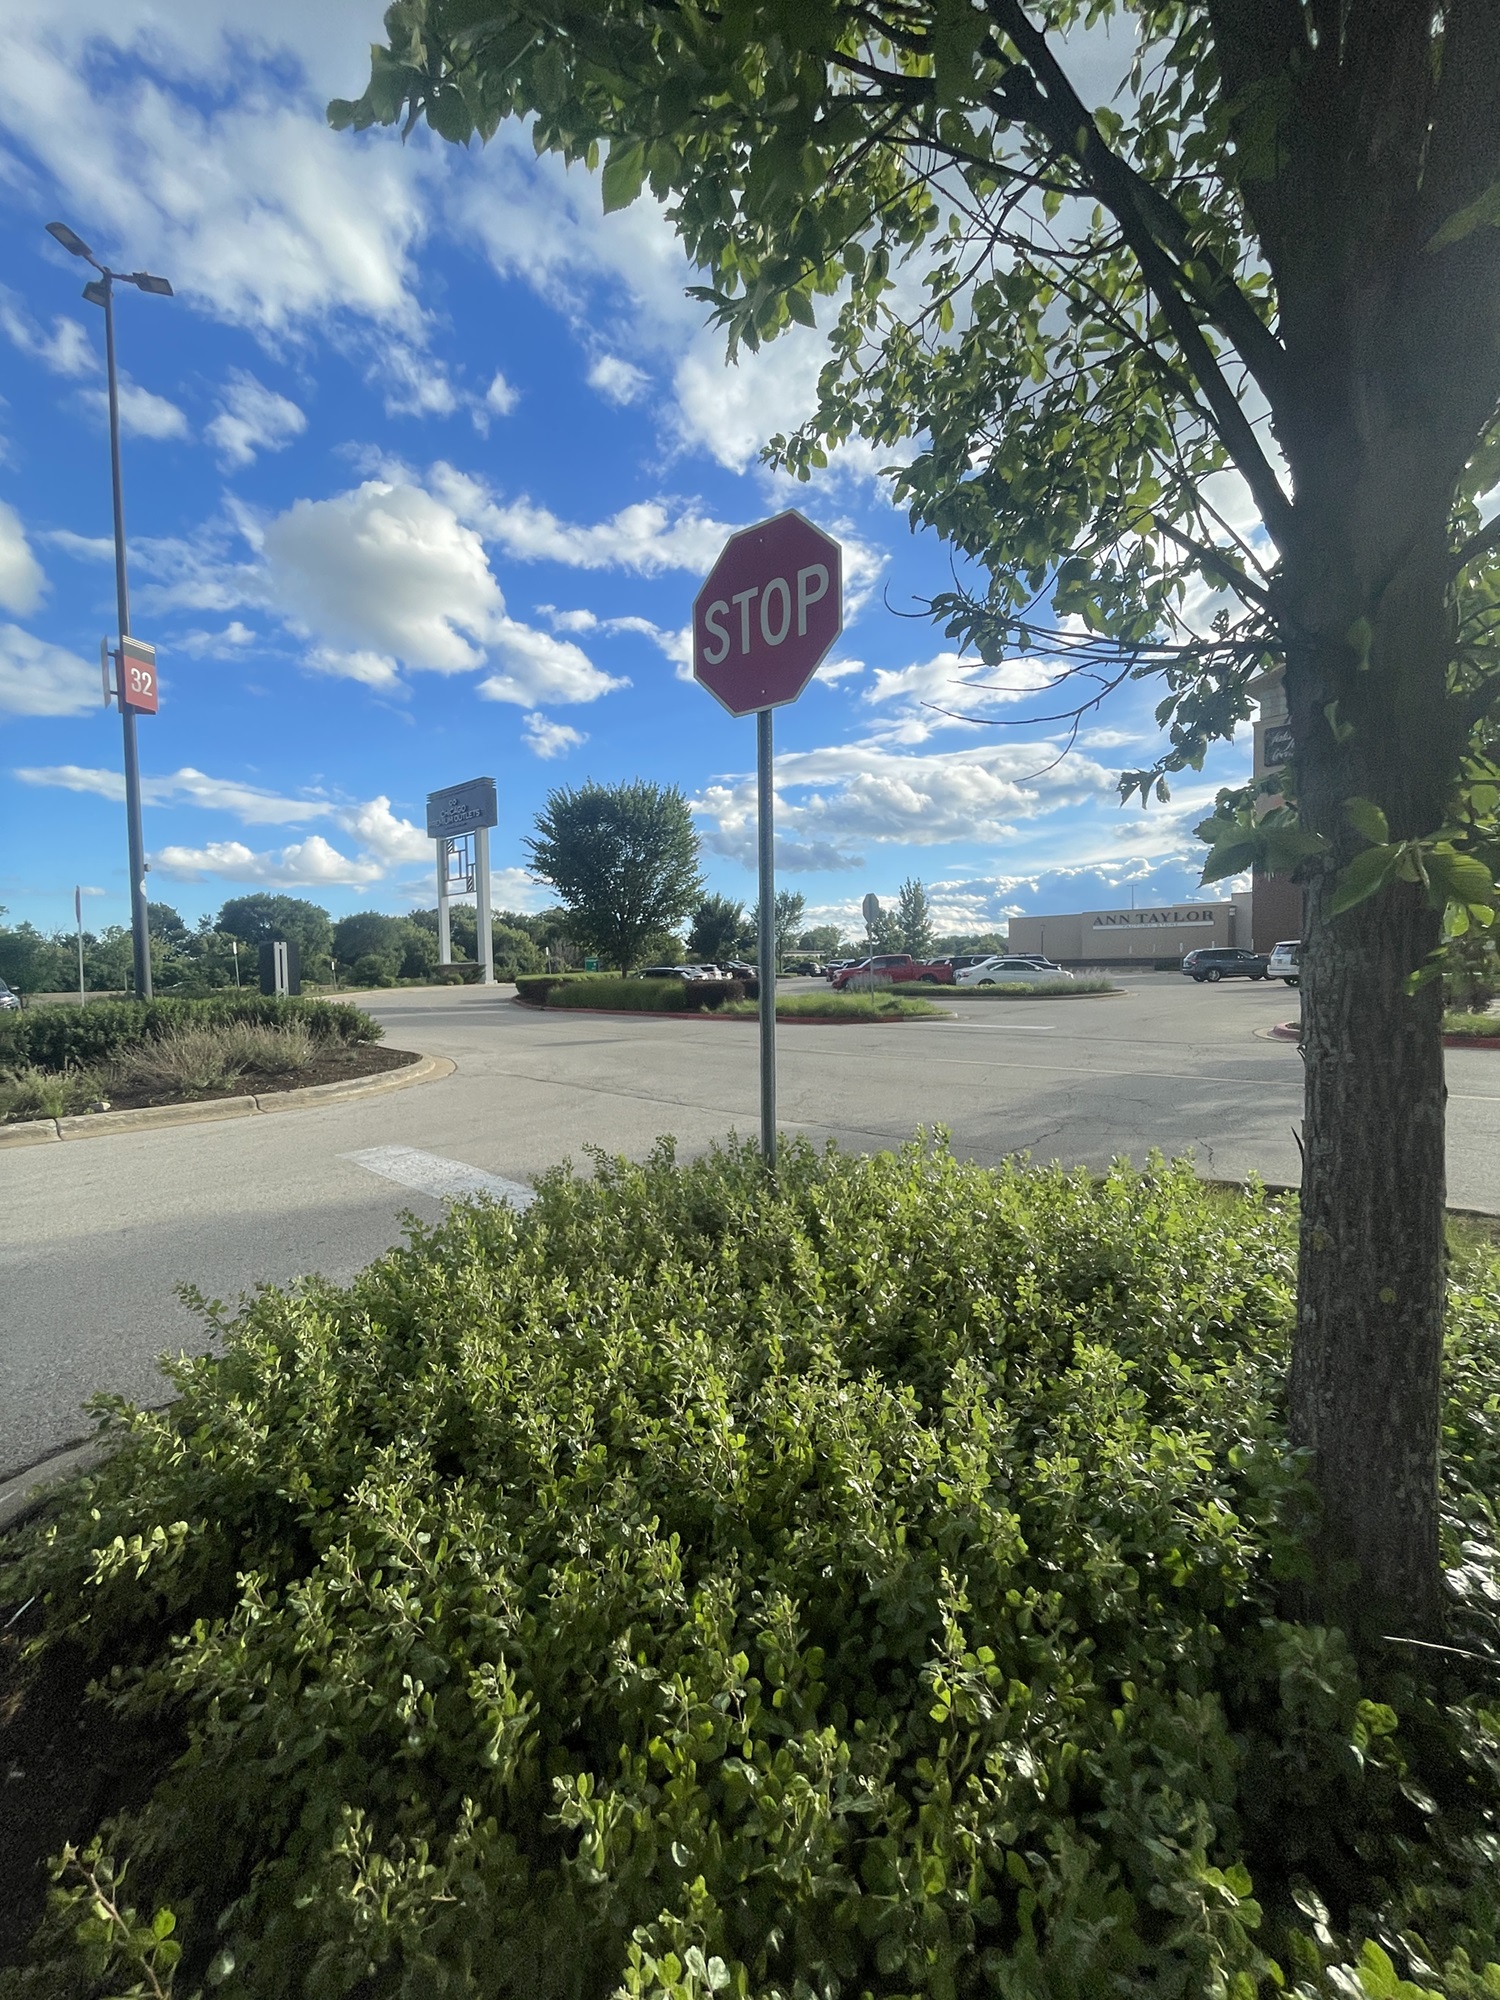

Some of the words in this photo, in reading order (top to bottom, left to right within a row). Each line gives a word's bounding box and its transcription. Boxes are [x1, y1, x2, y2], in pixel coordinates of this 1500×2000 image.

[703, 563, 830, 665] STOP
[130, 667, 153, 697] 32
[440, 804, 466, 818] CHICAGO
[454, 808, 480, 822] OUTLETS
[1093, 914, 1130, 926] ANN
[1136, 910, 1214, 923] TAYLOR
